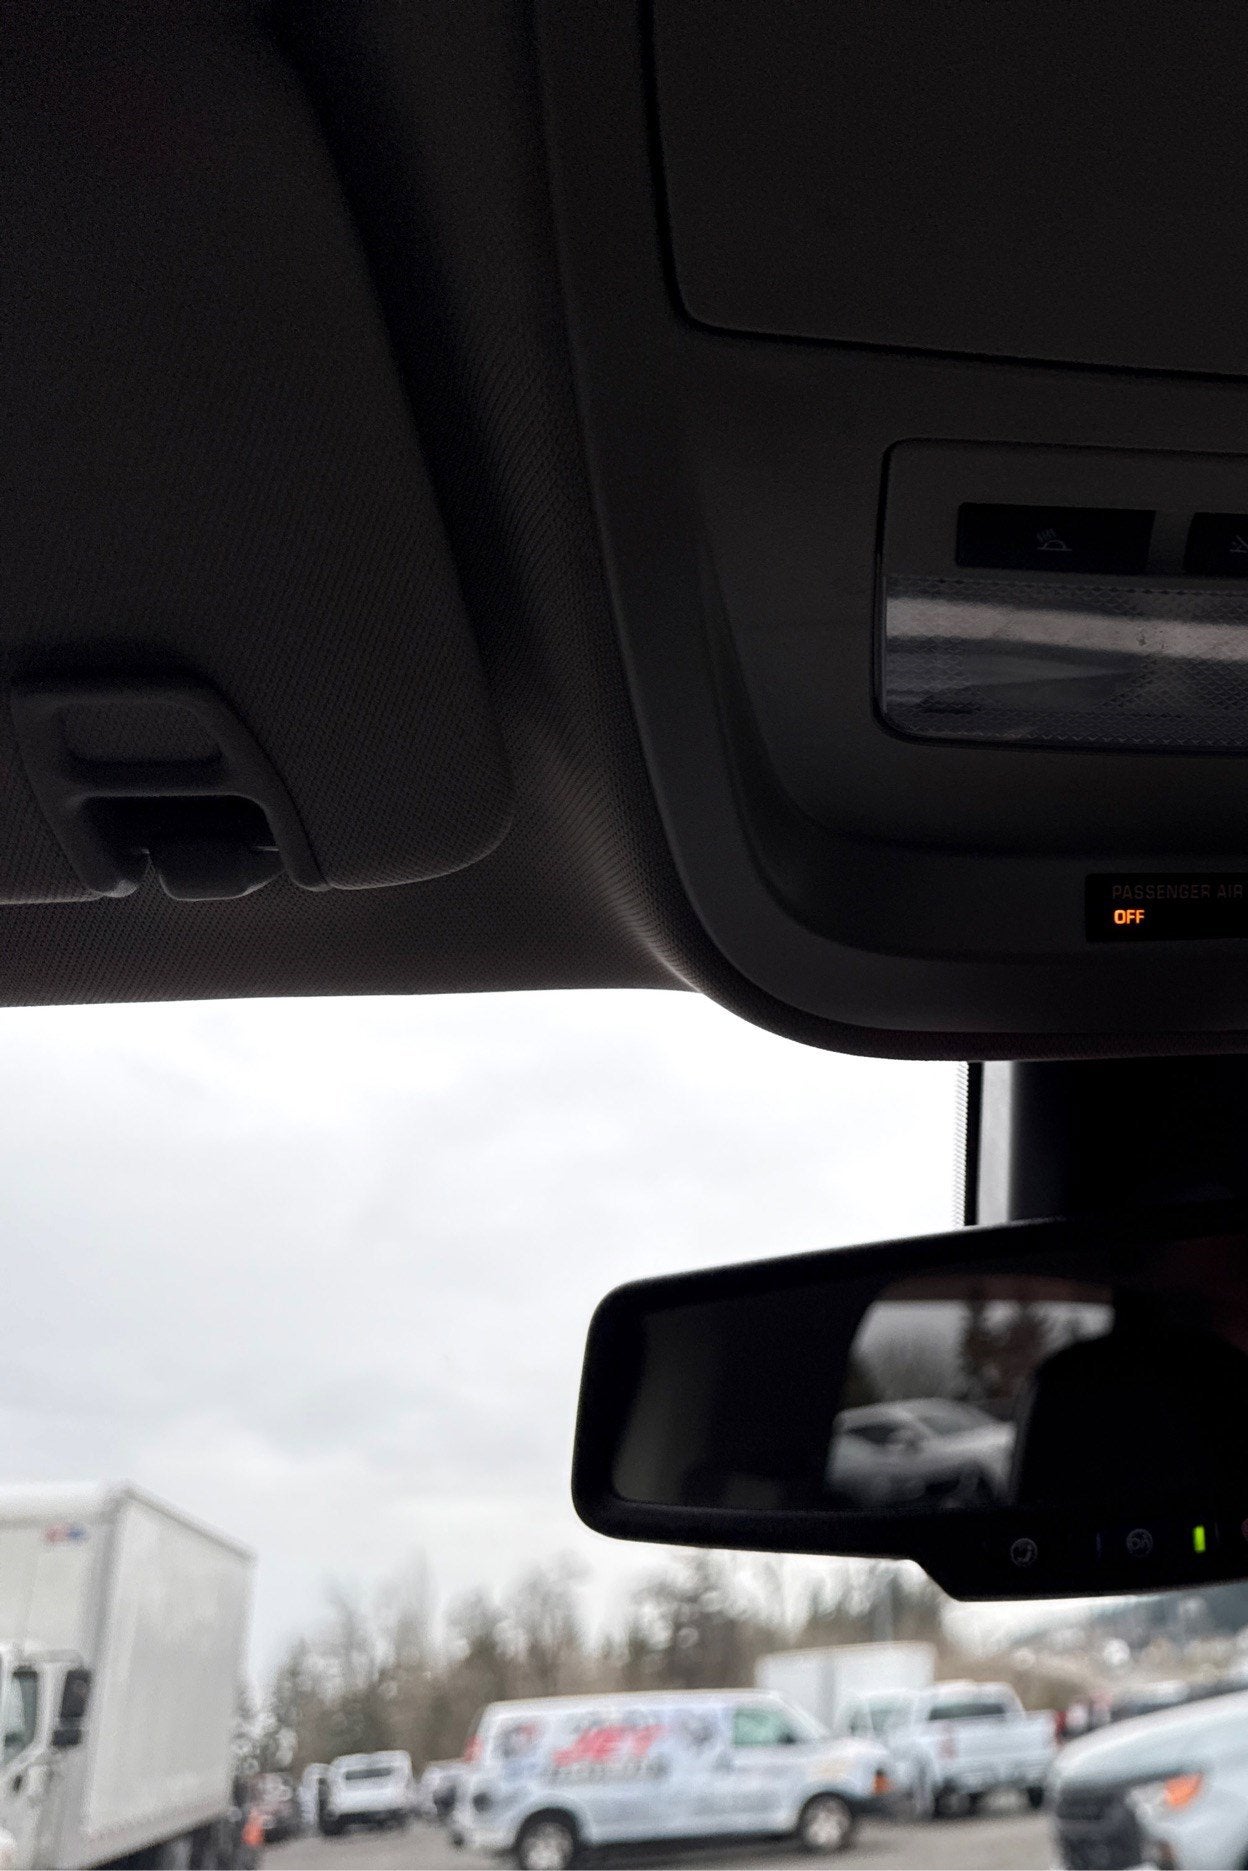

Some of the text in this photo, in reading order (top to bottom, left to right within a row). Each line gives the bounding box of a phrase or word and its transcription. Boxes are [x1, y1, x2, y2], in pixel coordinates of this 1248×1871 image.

[1111, 884, 1211, 900] PASSENGER
[1216, 884, 1244, 900] AIR
[1112, 909, 1147, 926] OFF
